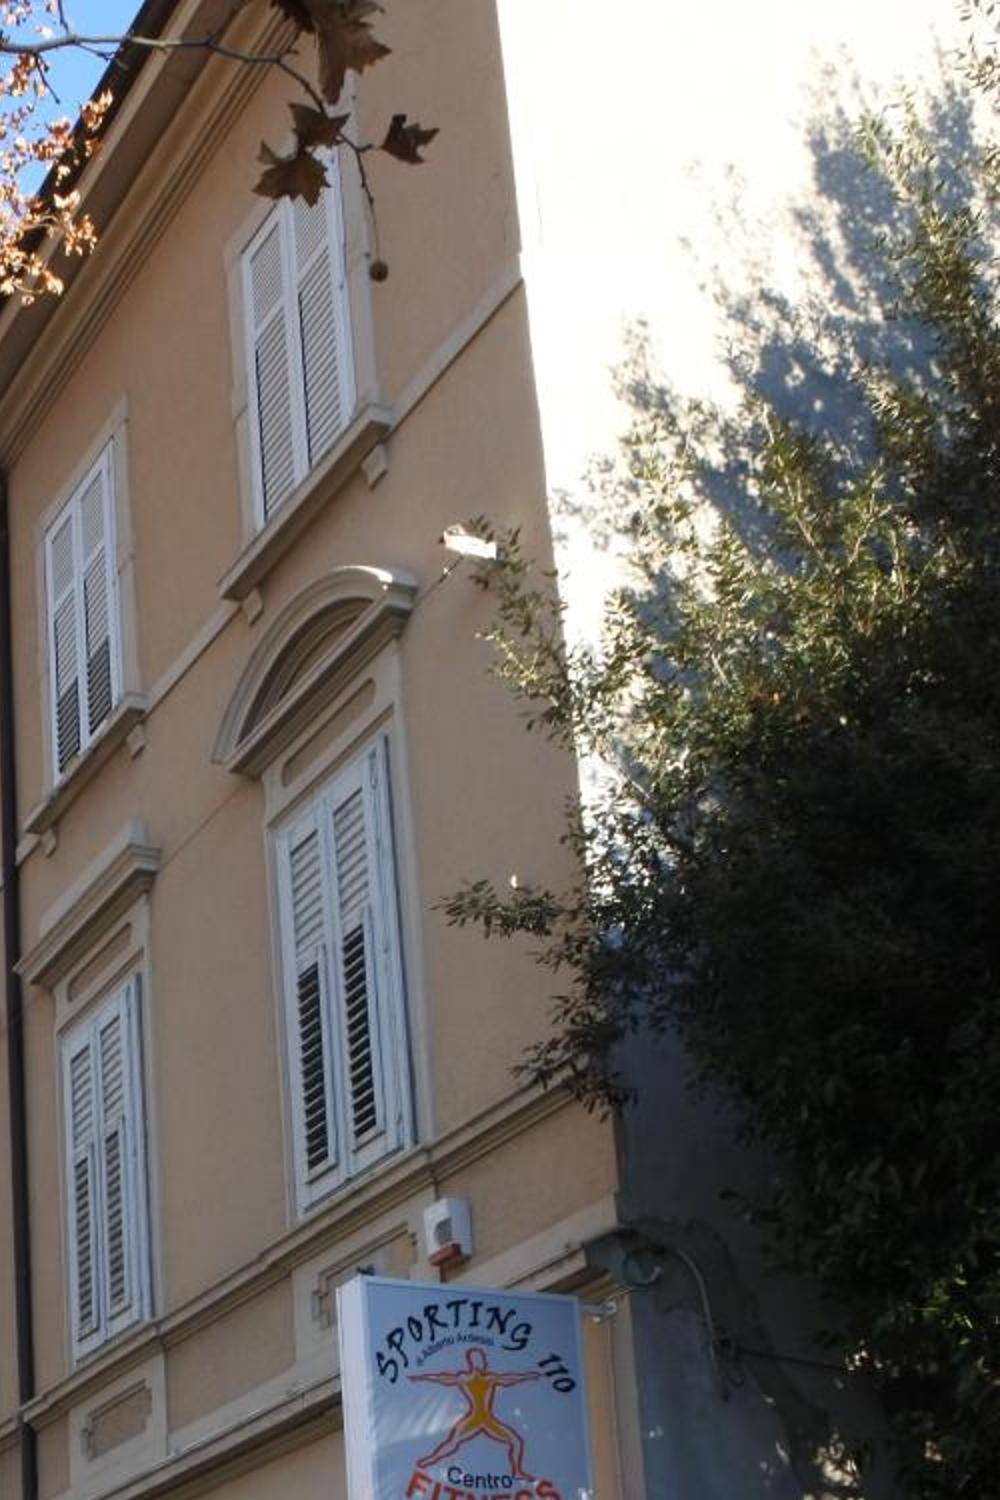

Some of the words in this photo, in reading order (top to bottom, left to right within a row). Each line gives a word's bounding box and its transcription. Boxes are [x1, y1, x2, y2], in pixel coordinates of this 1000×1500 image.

[376, 1299, 533, 1385] SPORTING
[537, 1353, 576, 1394] 110
[447, 1466, 514, 1489] Centro
